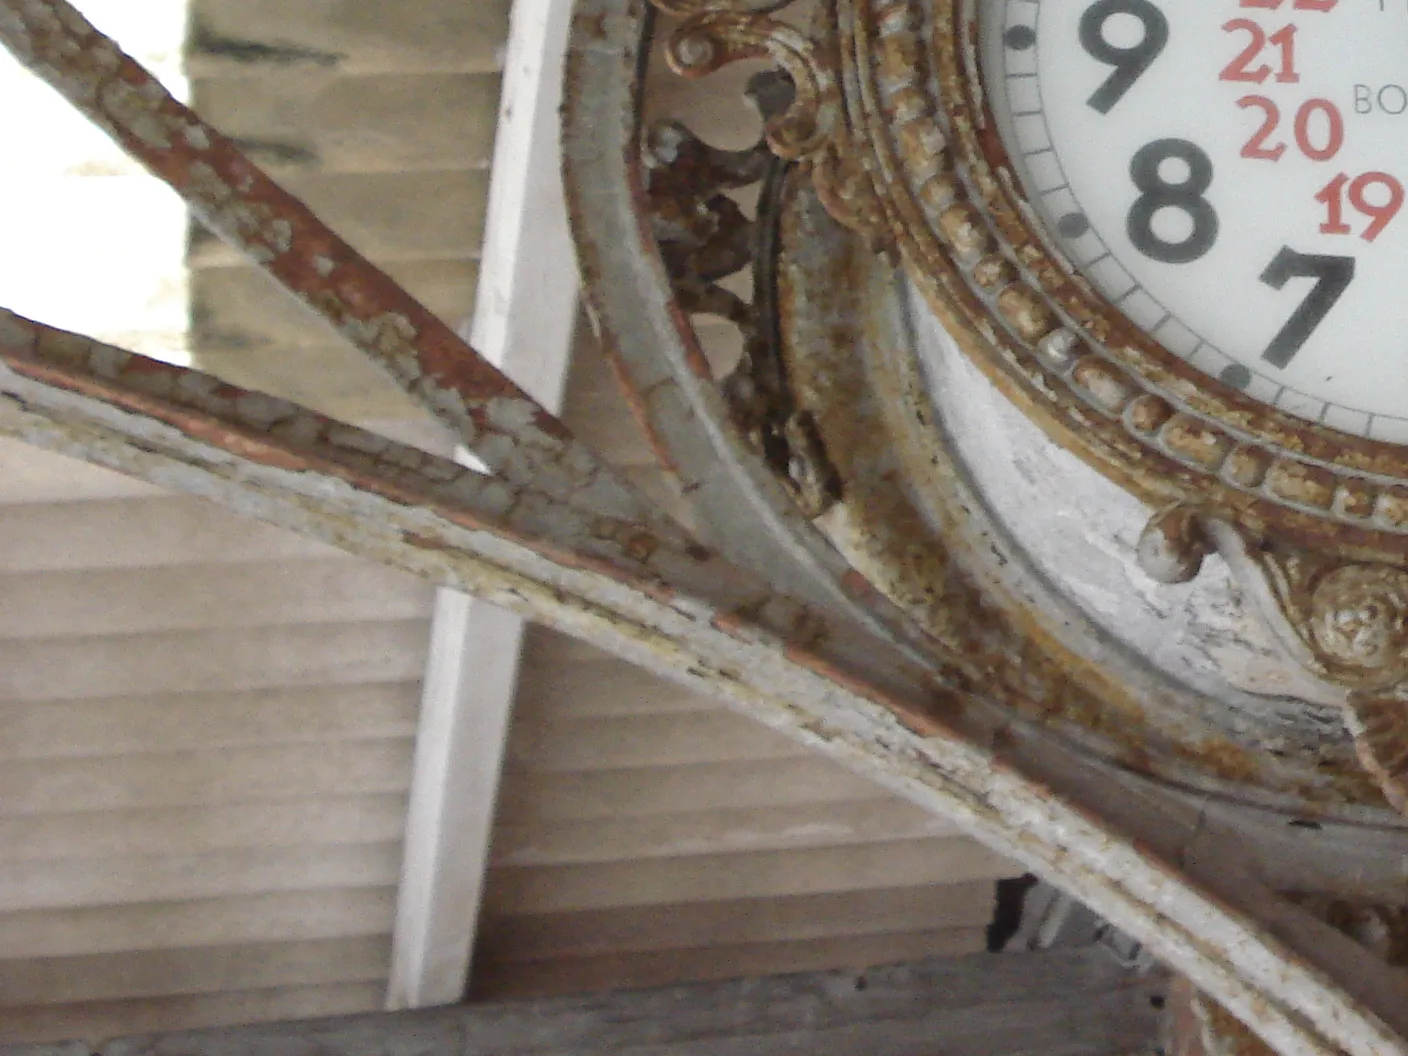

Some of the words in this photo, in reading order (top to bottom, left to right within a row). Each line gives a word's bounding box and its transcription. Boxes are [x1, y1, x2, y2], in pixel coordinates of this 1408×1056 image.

[1219, 19, 1298, 83] 21
[1239, 95, 1344, 162] 20
[1126, 138, 1219, 265] 8
[1315, 172, 1405, 242] 19
[1259, 246, 1356, 369] 7
